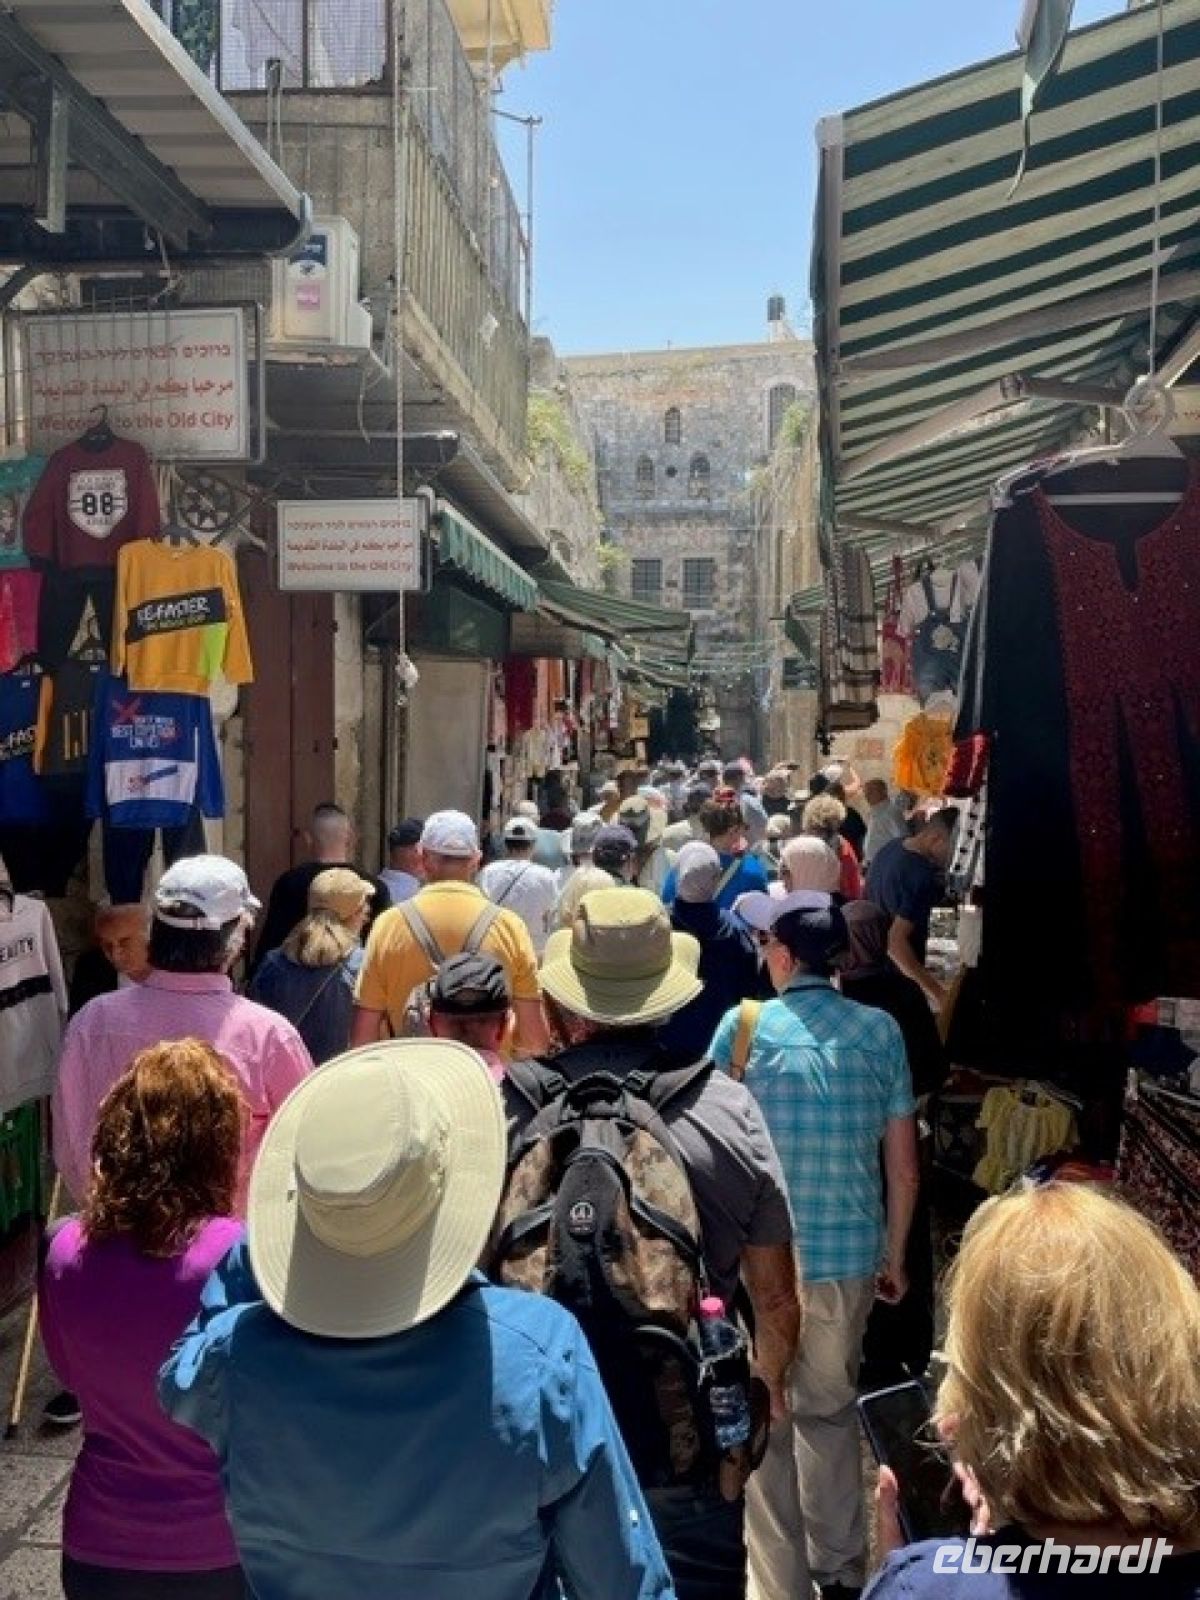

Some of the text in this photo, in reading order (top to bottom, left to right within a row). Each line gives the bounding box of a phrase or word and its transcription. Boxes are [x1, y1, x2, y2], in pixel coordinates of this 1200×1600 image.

[115, 413, 133, 429] to
[135, 412, 163, 429] the
[167, 411, 196, 429] Old
[200, 410, 233, 430] City
[82, 492, 113, 516] 88
[369, 559, 388, 571] Old
